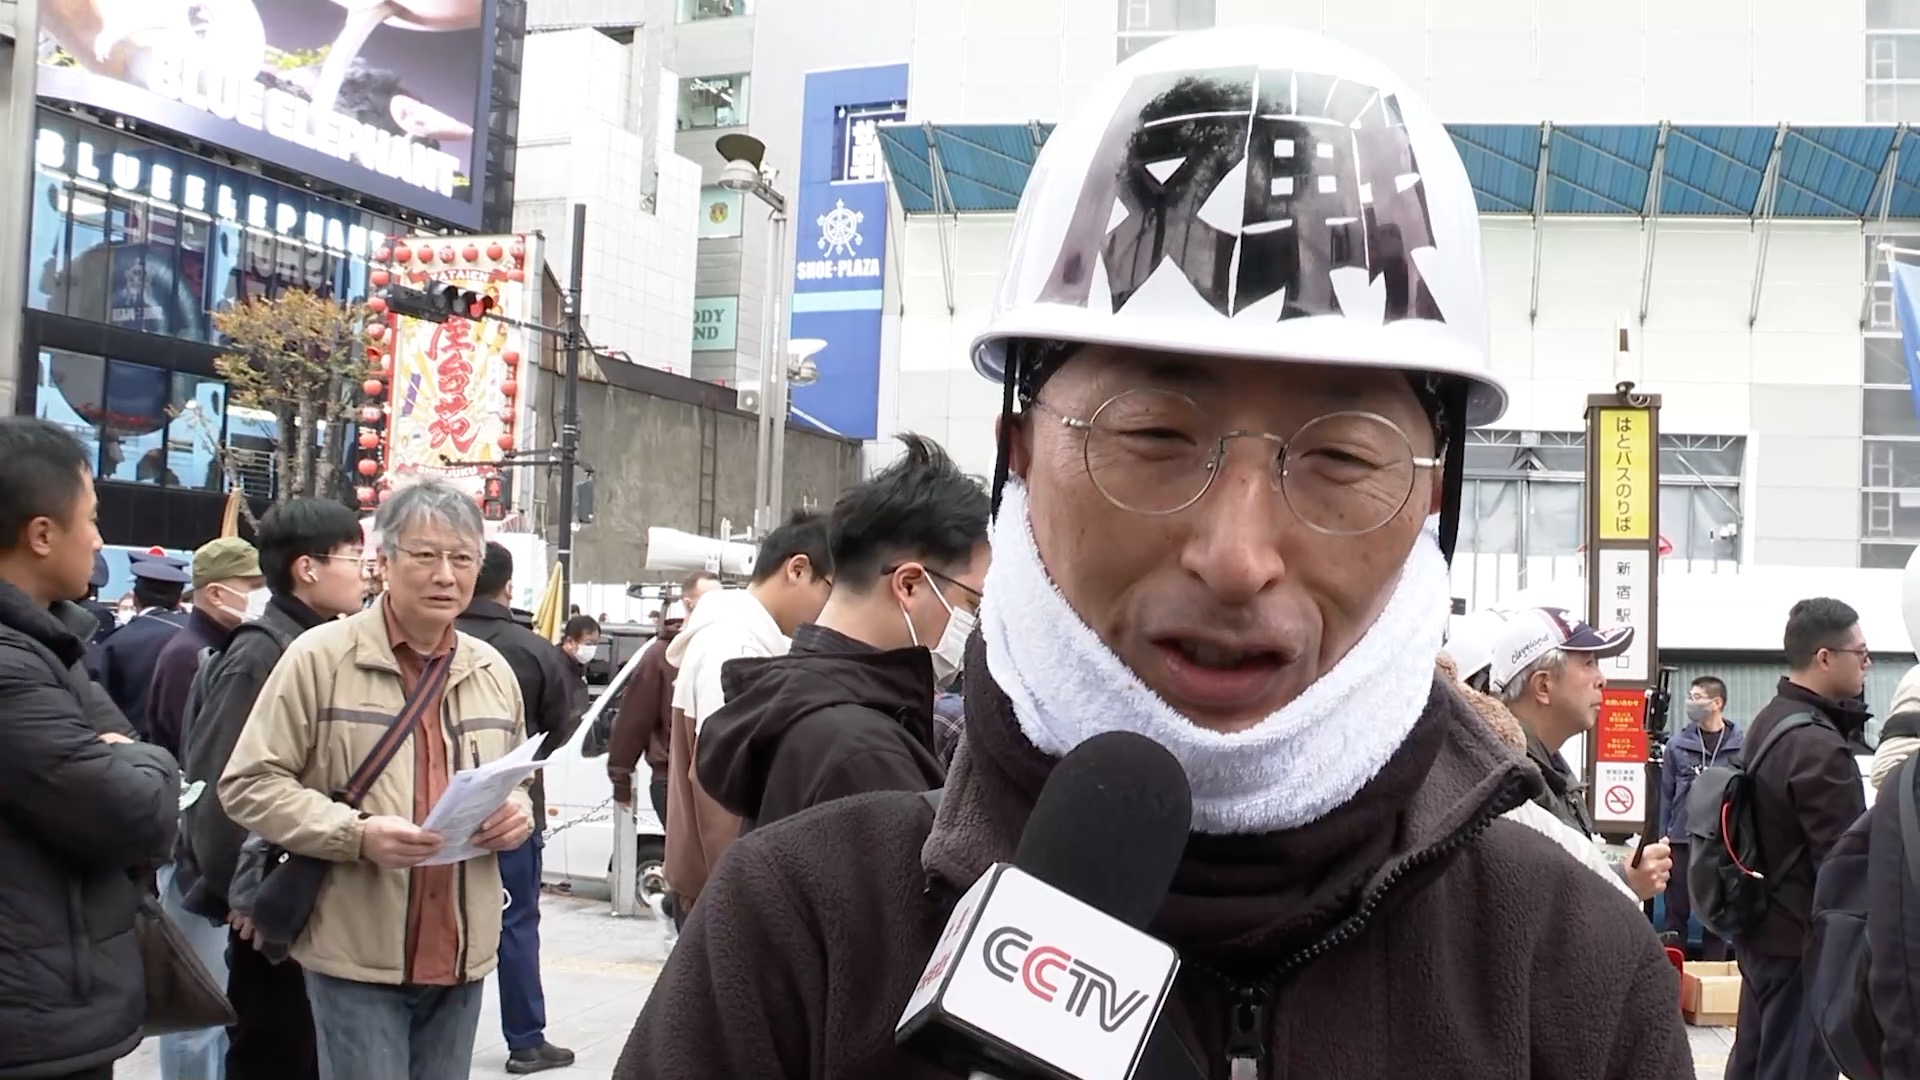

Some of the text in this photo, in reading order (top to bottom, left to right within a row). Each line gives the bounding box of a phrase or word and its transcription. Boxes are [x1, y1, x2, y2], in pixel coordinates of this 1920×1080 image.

[429, 269, 490, 281] YATAIEN
[1616, 417, 1632, 532] はとバスのりば
[1511, 633, 1549, 665] Cleveland
[1615, 561, 1632, 668] 新宿駅口
[982, 926, 1150, 1033] CCTV
